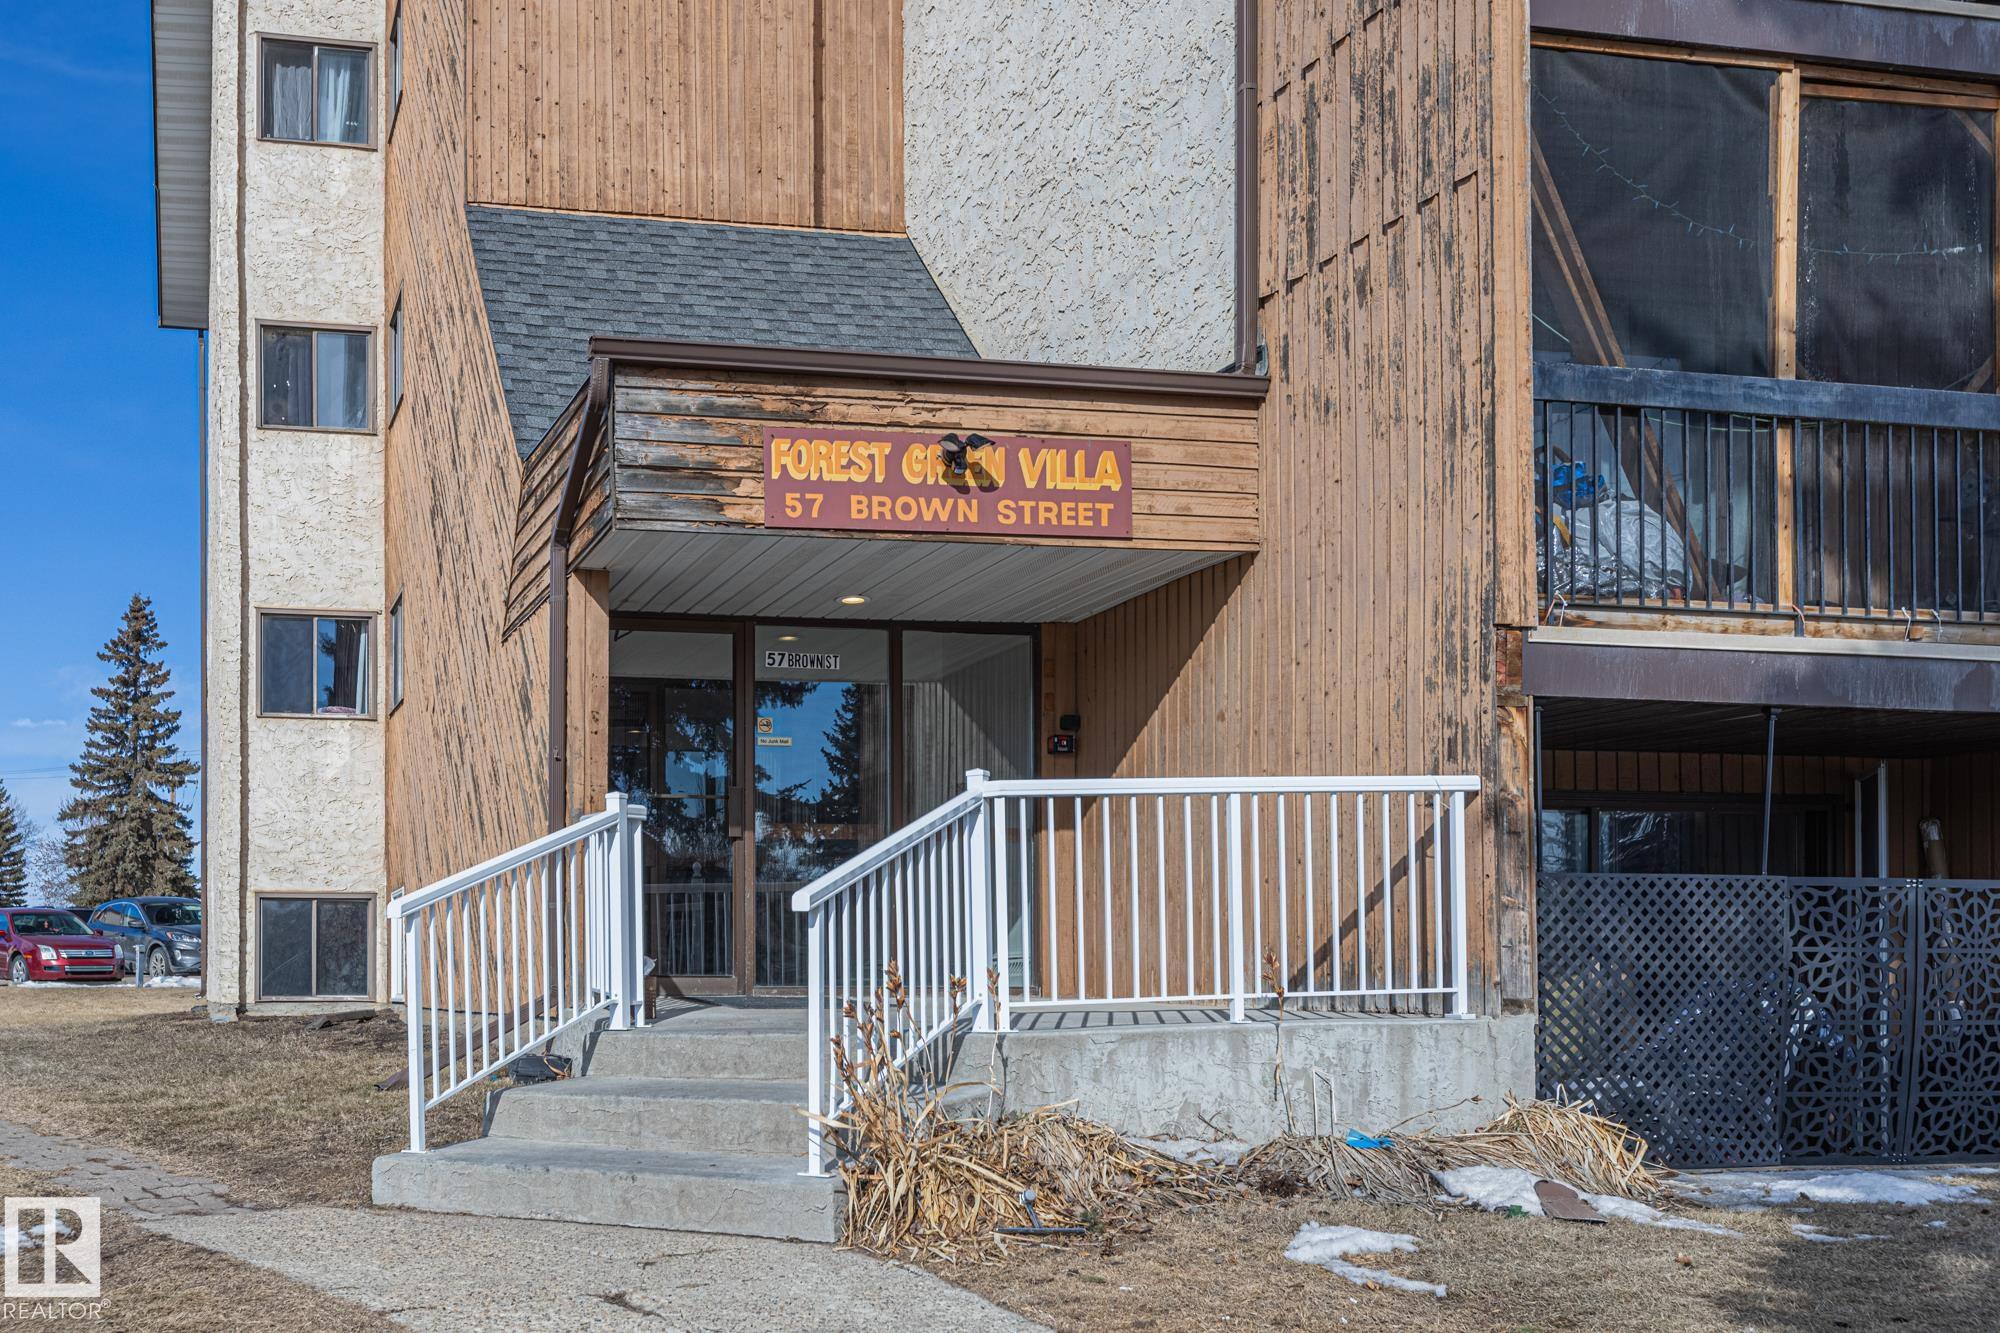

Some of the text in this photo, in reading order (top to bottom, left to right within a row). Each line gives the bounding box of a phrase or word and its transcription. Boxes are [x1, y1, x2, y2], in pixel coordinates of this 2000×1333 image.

[771, 438, 1122, 491] FOREST GREN VILLA
[784, 492, 1114, 527] 57 BROWN STREET
[766, 652, 839, 669] 57 BROWN ST
